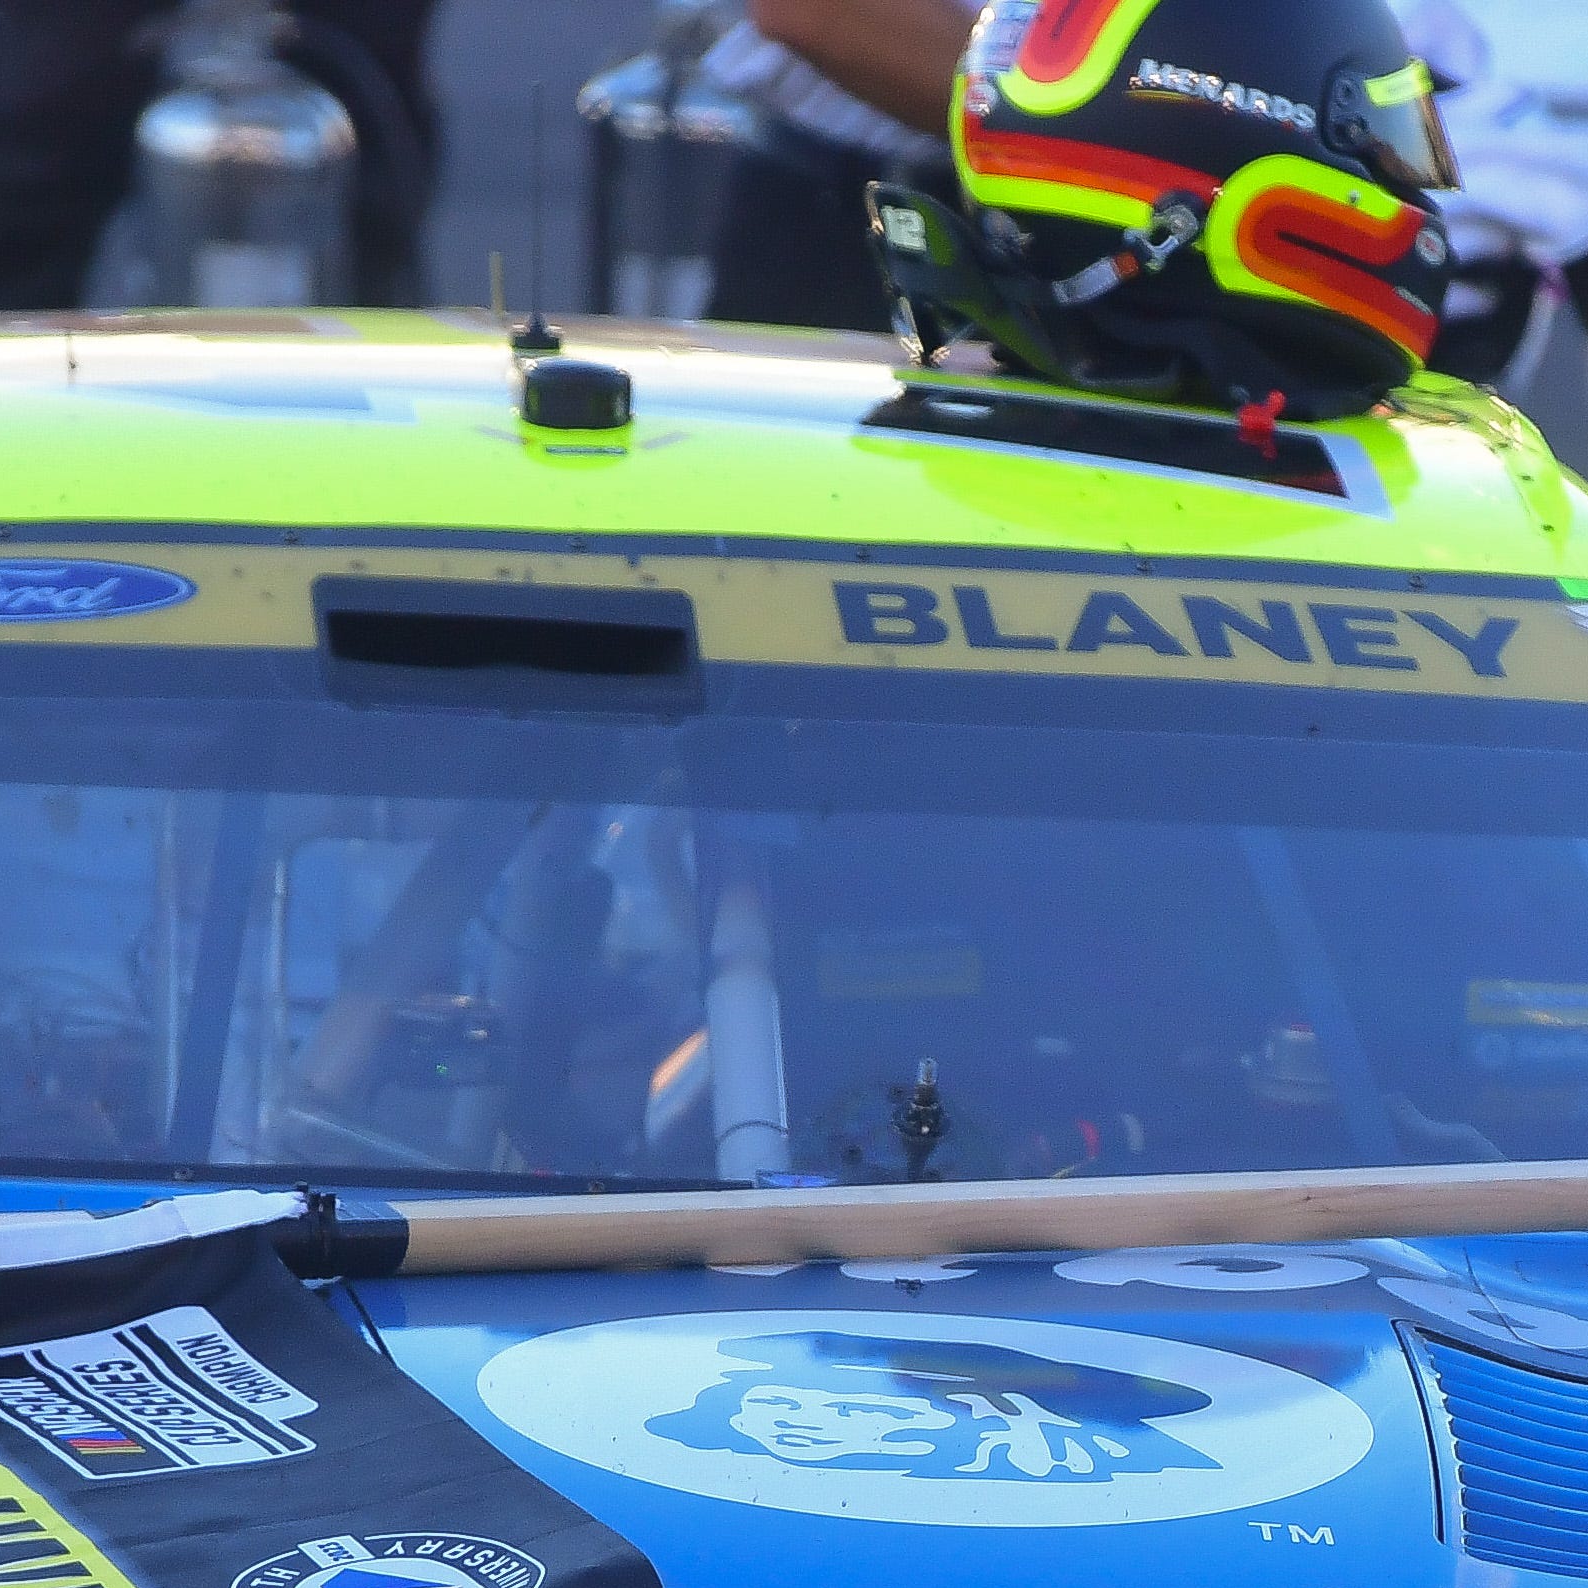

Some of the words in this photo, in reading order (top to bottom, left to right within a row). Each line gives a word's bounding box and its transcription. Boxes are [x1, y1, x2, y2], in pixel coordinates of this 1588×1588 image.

[1128, 58, 1316, 132] MENARDS
[832, 580, 1521, 680] BLANEY
[71, 1359, 188, 1420] SERIES
[176, 1332, 293, 1405] CHAMPION
[146, 1418, 244, 1446] CUP
[1248, 1520, 1338, 1547] TM
